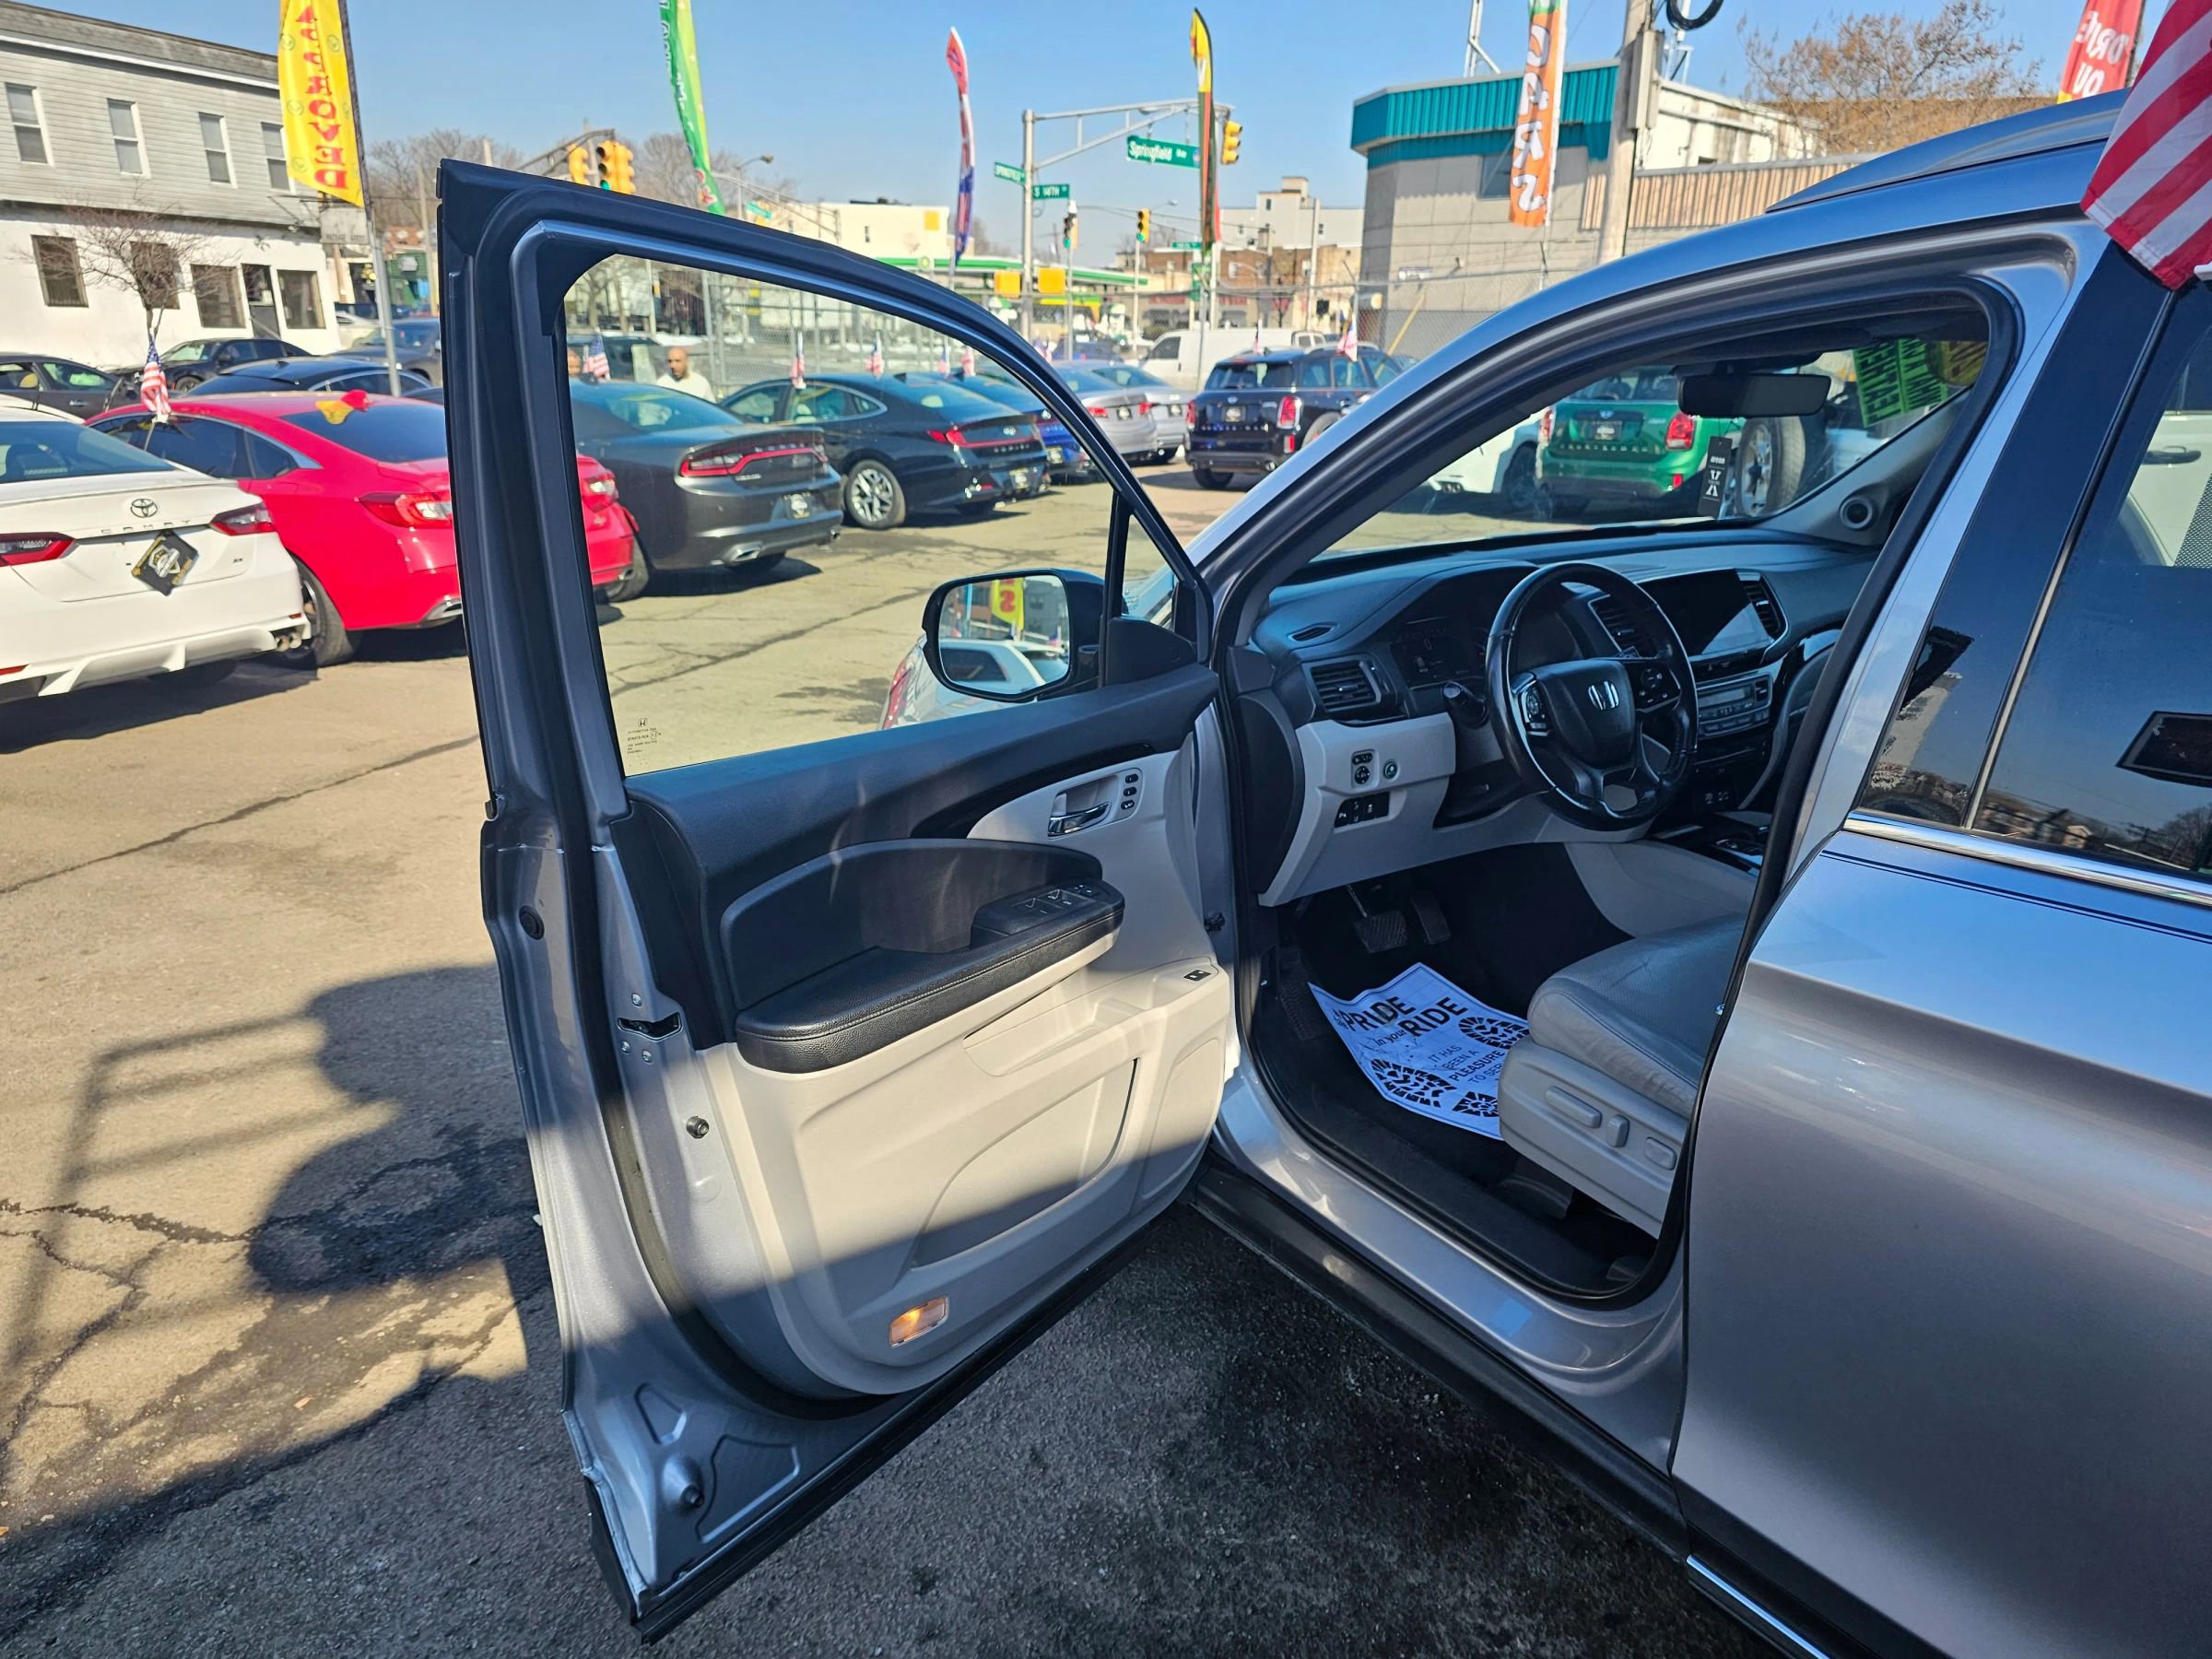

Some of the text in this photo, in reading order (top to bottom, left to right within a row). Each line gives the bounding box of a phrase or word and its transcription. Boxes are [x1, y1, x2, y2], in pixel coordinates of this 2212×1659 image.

[1338, 996, 1417, 1032] PRIDE
[1385, 1030, 1407, 1043] your
[1400, 997, 1468, 1037] RIDE
[1428, 1045, 1462, 1063] IT HAS
[1441, 1053, 1471, 1069] BEEN
[1449, 1050, 1505, 1081] PLEASURE
[1467, 1064, 1502, 1083] TO SER
